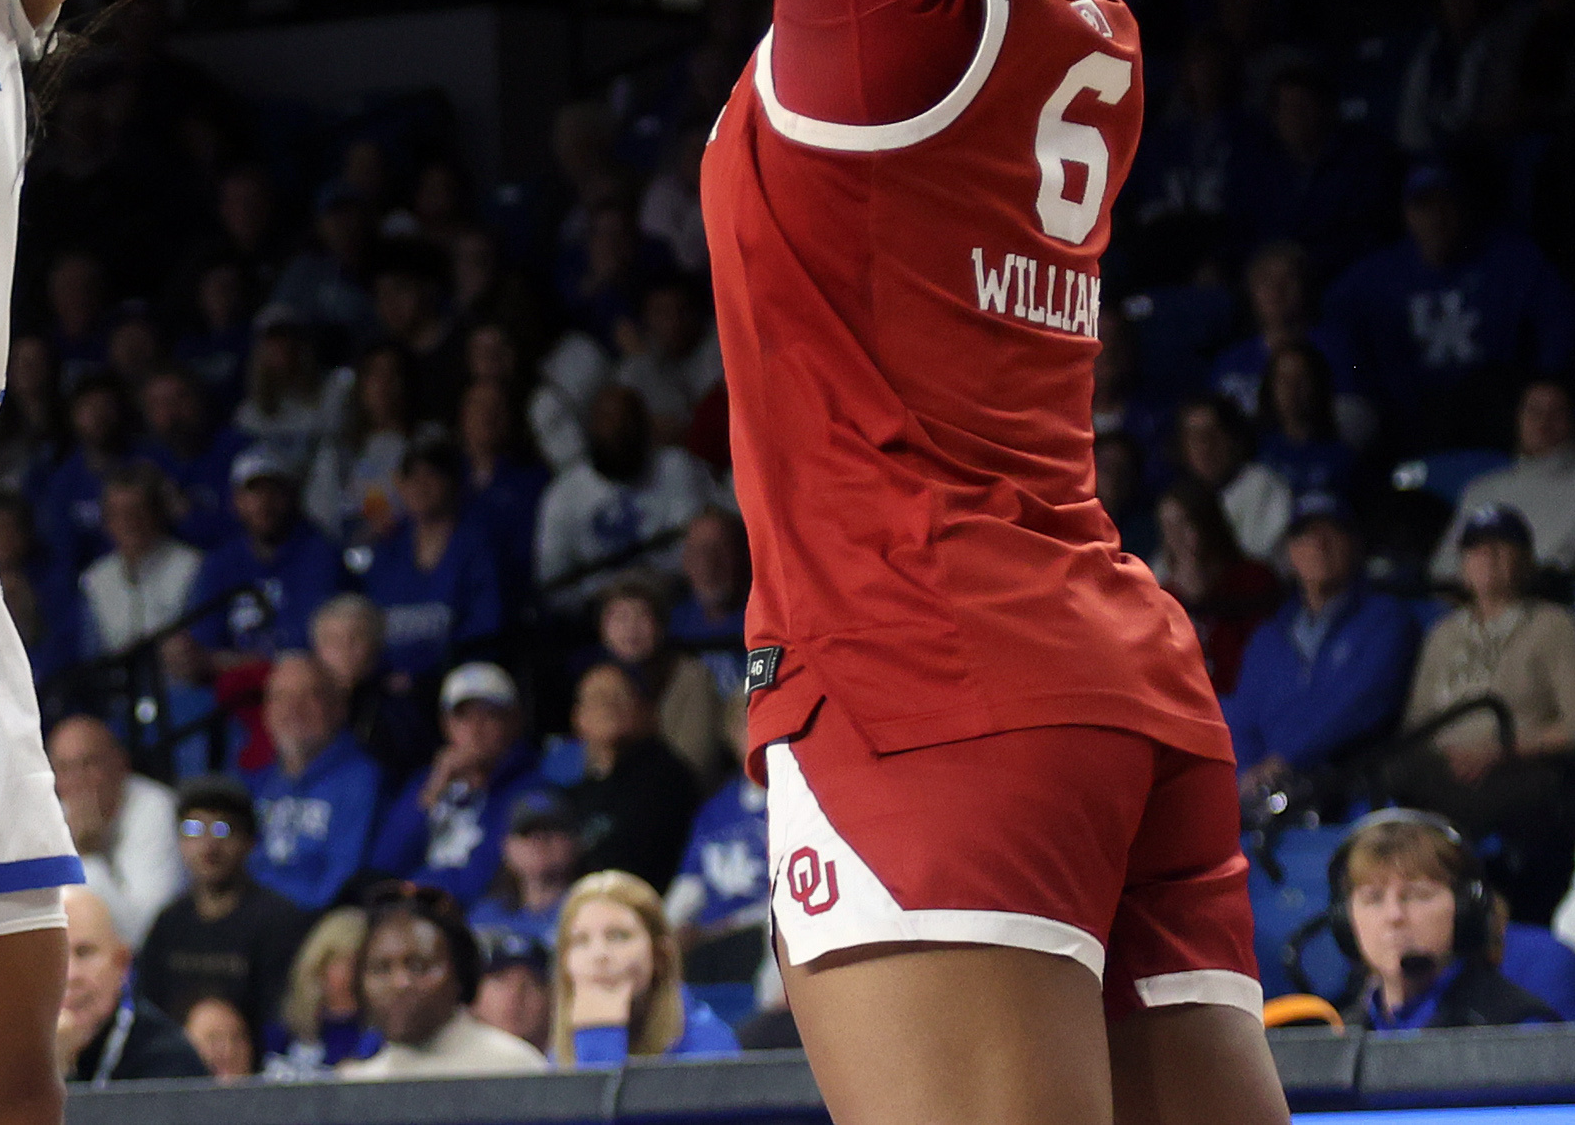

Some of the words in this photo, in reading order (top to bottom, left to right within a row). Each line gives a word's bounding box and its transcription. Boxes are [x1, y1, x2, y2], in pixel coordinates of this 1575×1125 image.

[1035, 50, 1133, 245] 6
[750, 659, 765, 676] 46
[787, 846, 840, 917] OU
